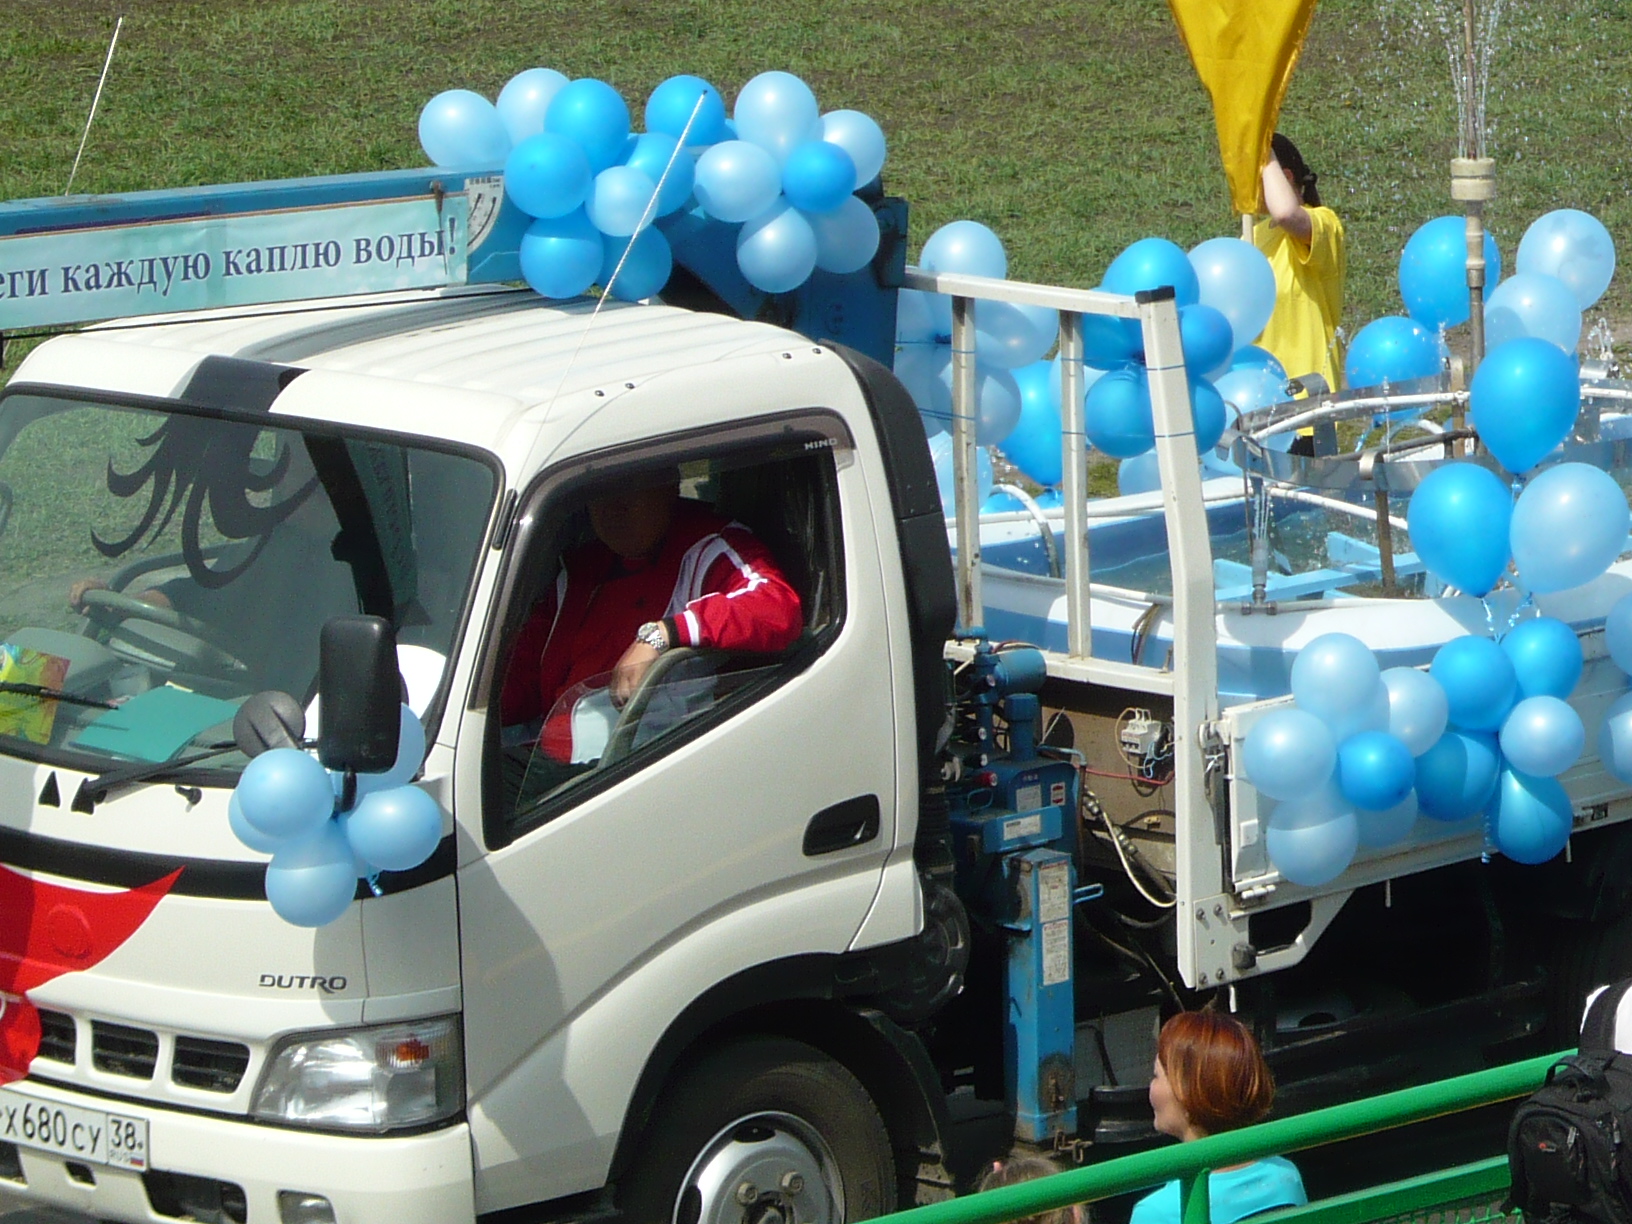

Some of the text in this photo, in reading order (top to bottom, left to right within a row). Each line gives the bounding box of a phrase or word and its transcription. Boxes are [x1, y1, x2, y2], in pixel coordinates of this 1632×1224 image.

[61, 252, 211, 296] каждую
[222, 238, 341, 277] каплю
[353, 217, 456, 267] воды!
[259, 974, 347, 994] DUTRO
[110, 1118, 136, 1151] 38
